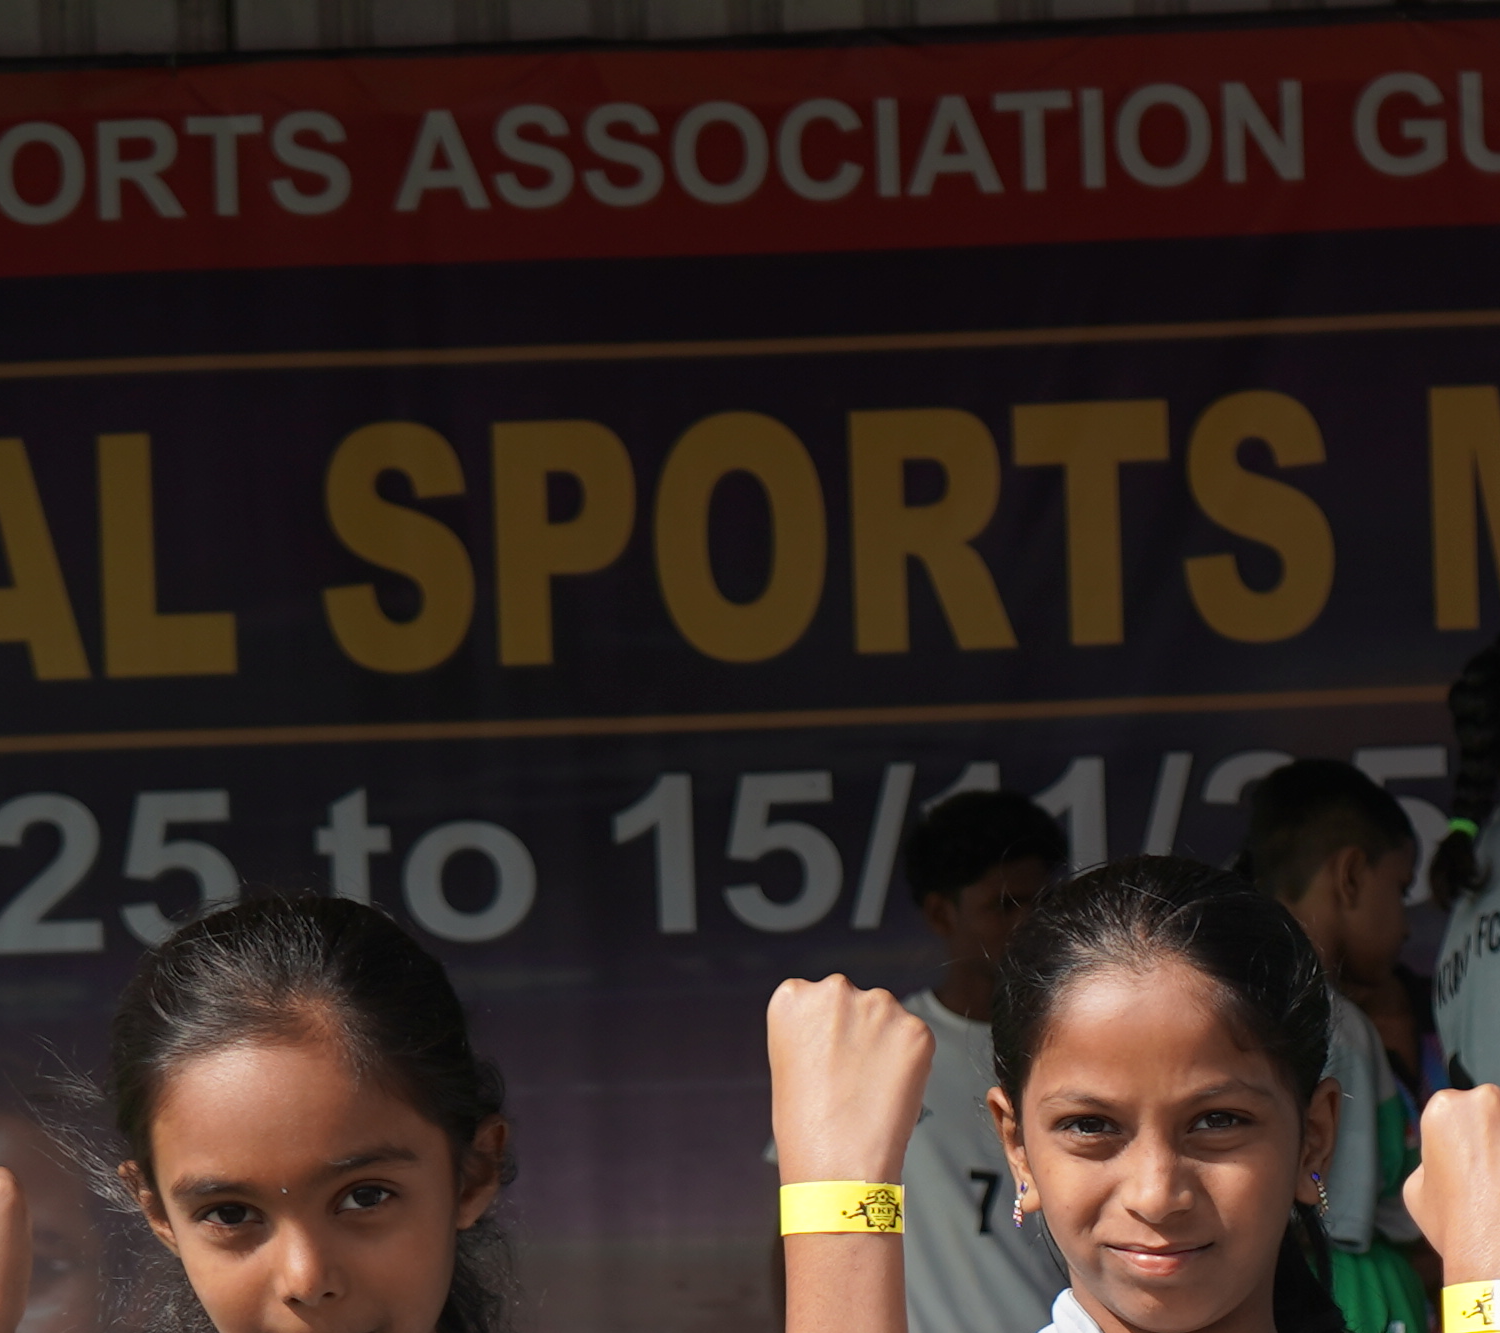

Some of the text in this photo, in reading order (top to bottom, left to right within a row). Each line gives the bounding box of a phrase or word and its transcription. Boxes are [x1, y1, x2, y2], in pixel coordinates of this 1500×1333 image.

[394, 81, 1306, 212] ASSOCIATION
[323, 390, 1336, 675] SPORTS
[317, 789, 537, 942] to
[970, 1171, 999, 1235] 7
